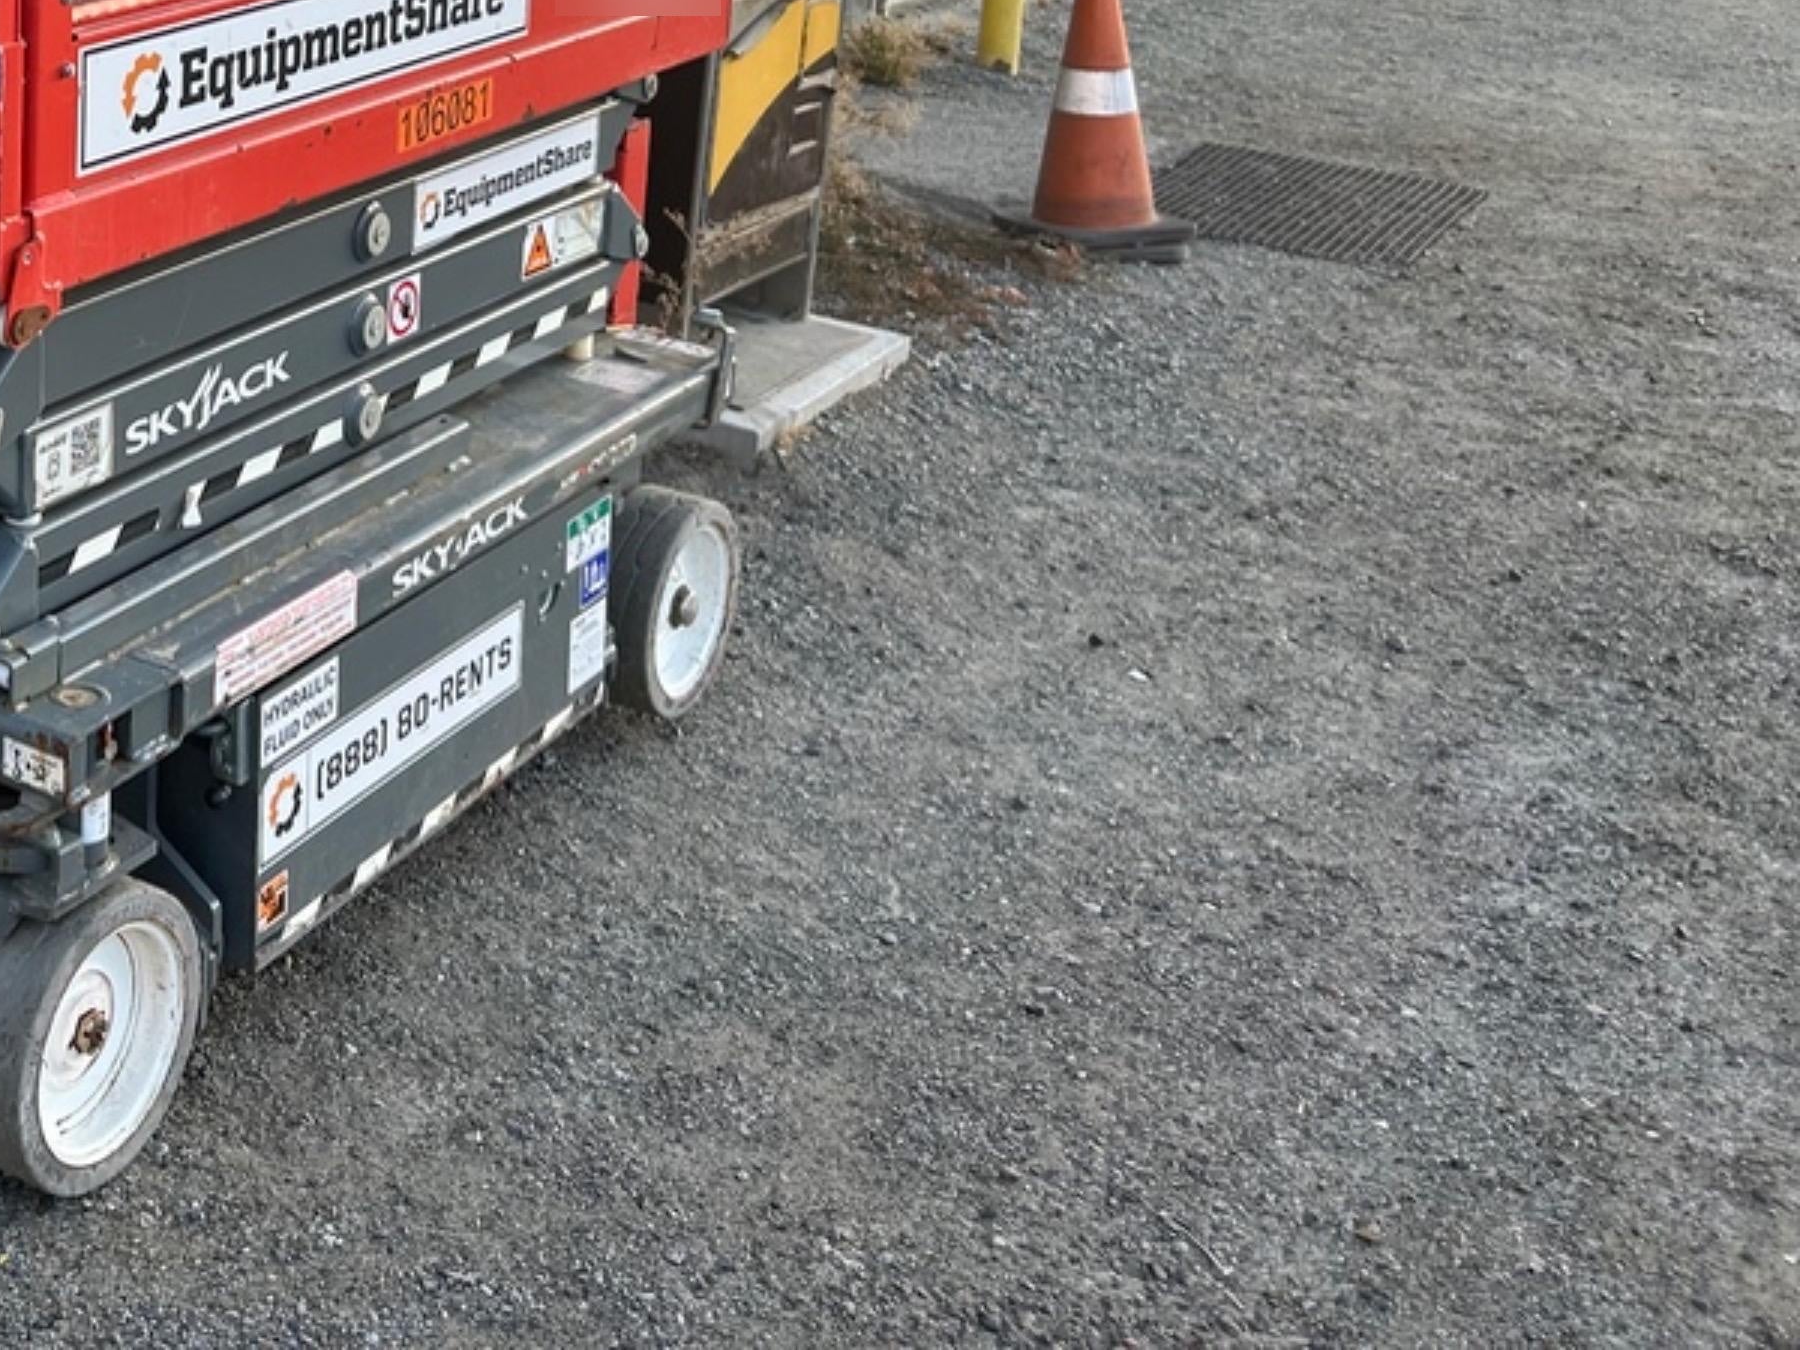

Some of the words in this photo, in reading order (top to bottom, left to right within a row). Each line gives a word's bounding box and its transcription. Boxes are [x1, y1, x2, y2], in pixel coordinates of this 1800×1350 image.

[401, 83, 490, 147] 106081
[442, 135, 593, 218] EquipmentShare
[125, 352, 290, 454] SKYJACK
[391, 497, 529, 598] SKYJACK
[263, 664, 336, 727] HYDRAULIC
[263, 719, 300, 756] FLUID
[303, 697, 334, 730] ONLY
[316, 717, 388, 800] (888)
[397, 637, 512, 743] 80-RENTS
